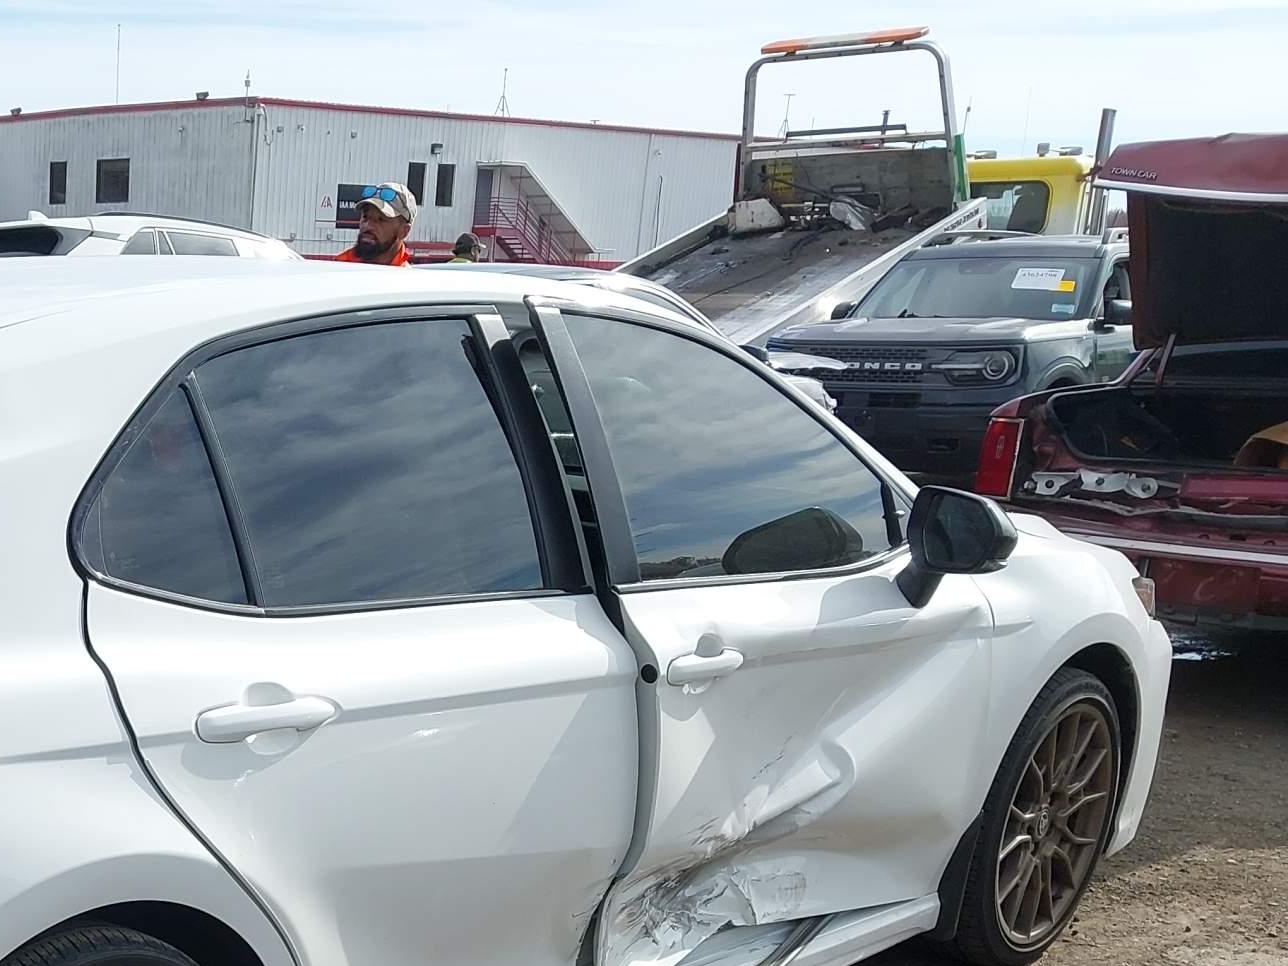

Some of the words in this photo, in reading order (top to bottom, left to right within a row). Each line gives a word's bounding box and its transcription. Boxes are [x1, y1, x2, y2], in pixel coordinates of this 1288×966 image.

[1111, 167, 1138, 177] TOWN
[1137, 170, 1158, 180] CAR
[844, 361, 923, 370] ONCO
